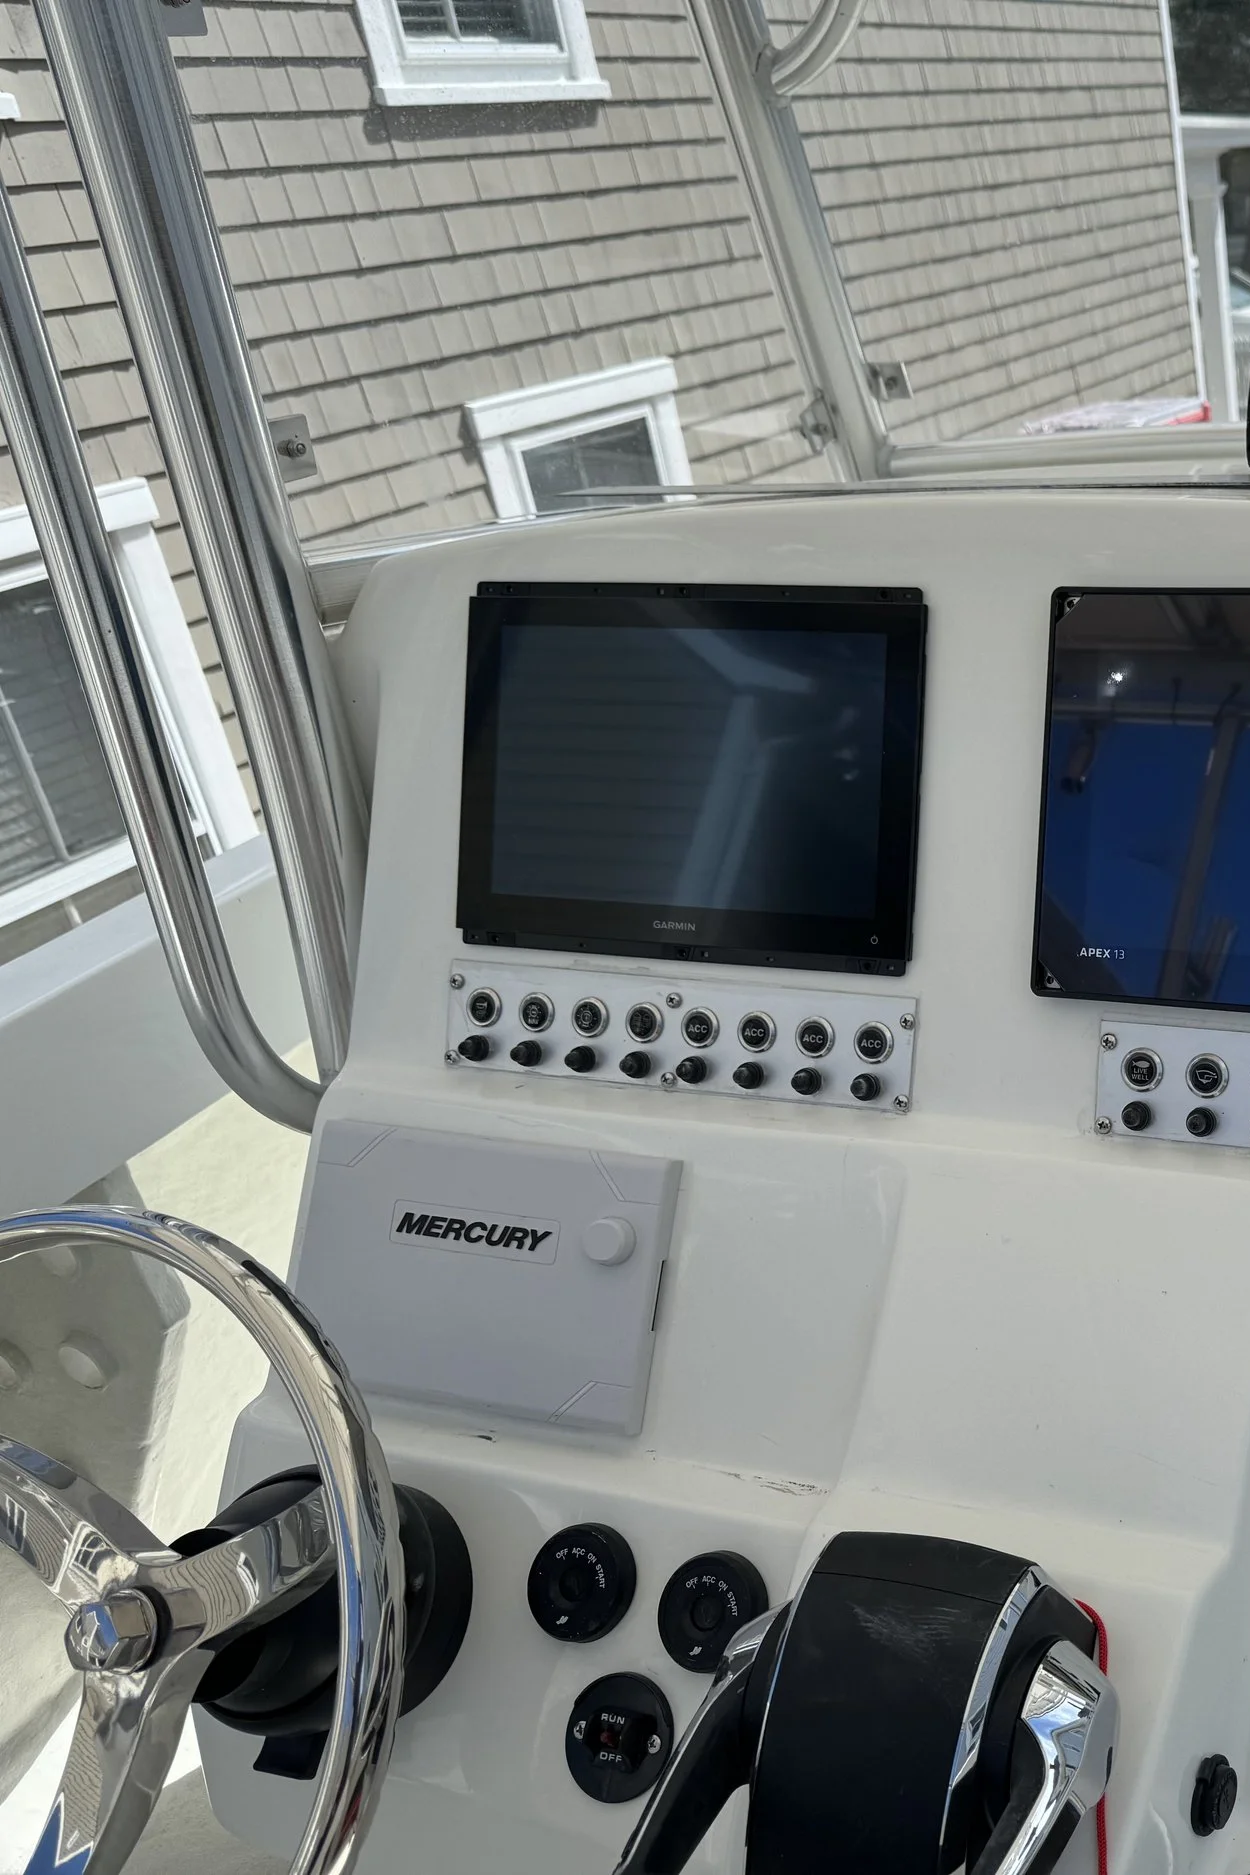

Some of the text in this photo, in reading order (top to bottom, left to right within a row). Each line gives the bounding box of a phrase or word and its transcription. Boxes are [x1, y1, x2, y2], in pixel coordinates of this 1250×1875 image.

[653, 920, 696, 931] GARMIN
[1079, 947, 1125, 960] APEX 13
[687, 1024, 708, 1034] ACC
[744, 1028, 765, 1037] ACC
[802, 1034, 823, 1044] ACC
[860, 1039, 881, 1049] ACC
[1131, 1073, 1149, 1081] WELL
[395, 1212, 552, 1251] MERCURY
[555, 1547, 605, 1589] OFF ACC ON START
[685, 1575, 738, 1617] OFF ACC ON START
[600, 1713, 625, 1725] RUN
[600, 1752, 623, 1763] OFF
